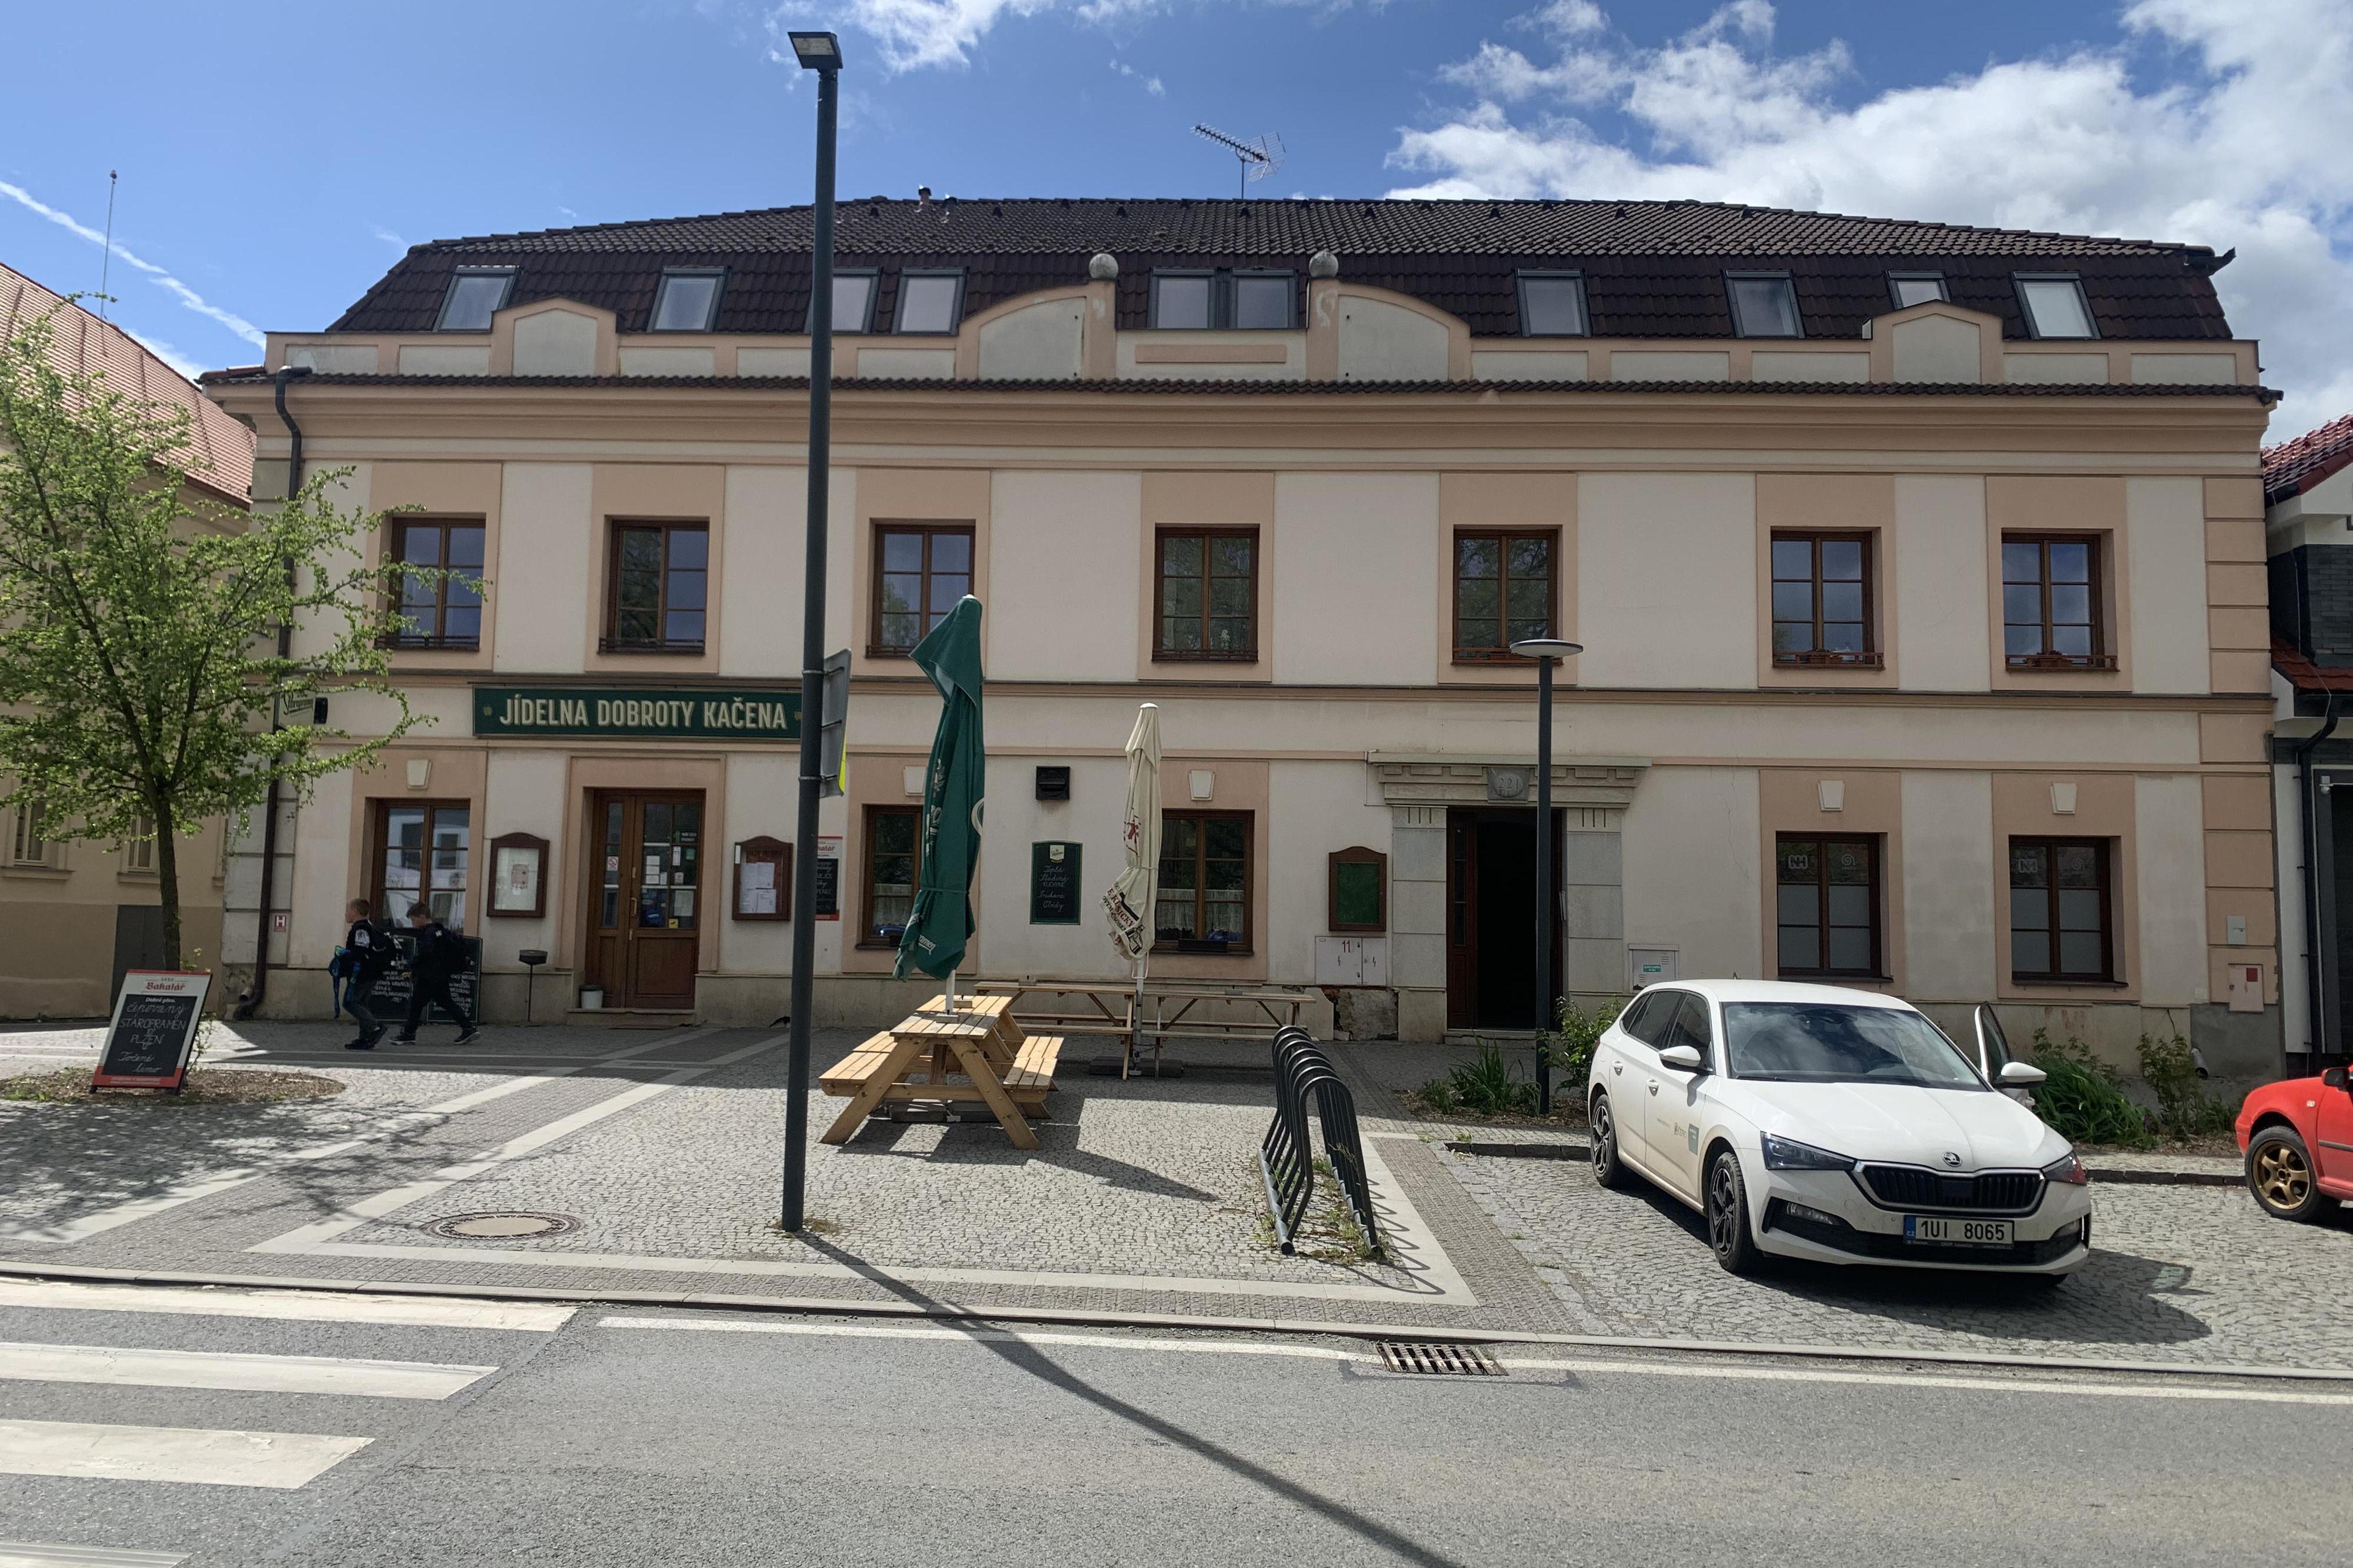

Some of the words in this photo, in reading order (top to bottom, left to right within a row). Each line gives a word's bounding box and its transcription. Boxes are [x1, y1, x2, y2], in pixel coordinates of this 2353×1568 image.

[500, 693, 588, 726] JÍDELNA
[597, 699, 695, 728] DOBROTY
[704, 696, 788, 730] KAČENA
[276, 916, 285, 926] H
[1342, 940, 1351, 953] 11
[118, 1017, 186, 1030] STAROPRAMEN
[1921, 1220, 1948, 1239] 1UI
[1964, 1223, 2005, 1241] 8065
